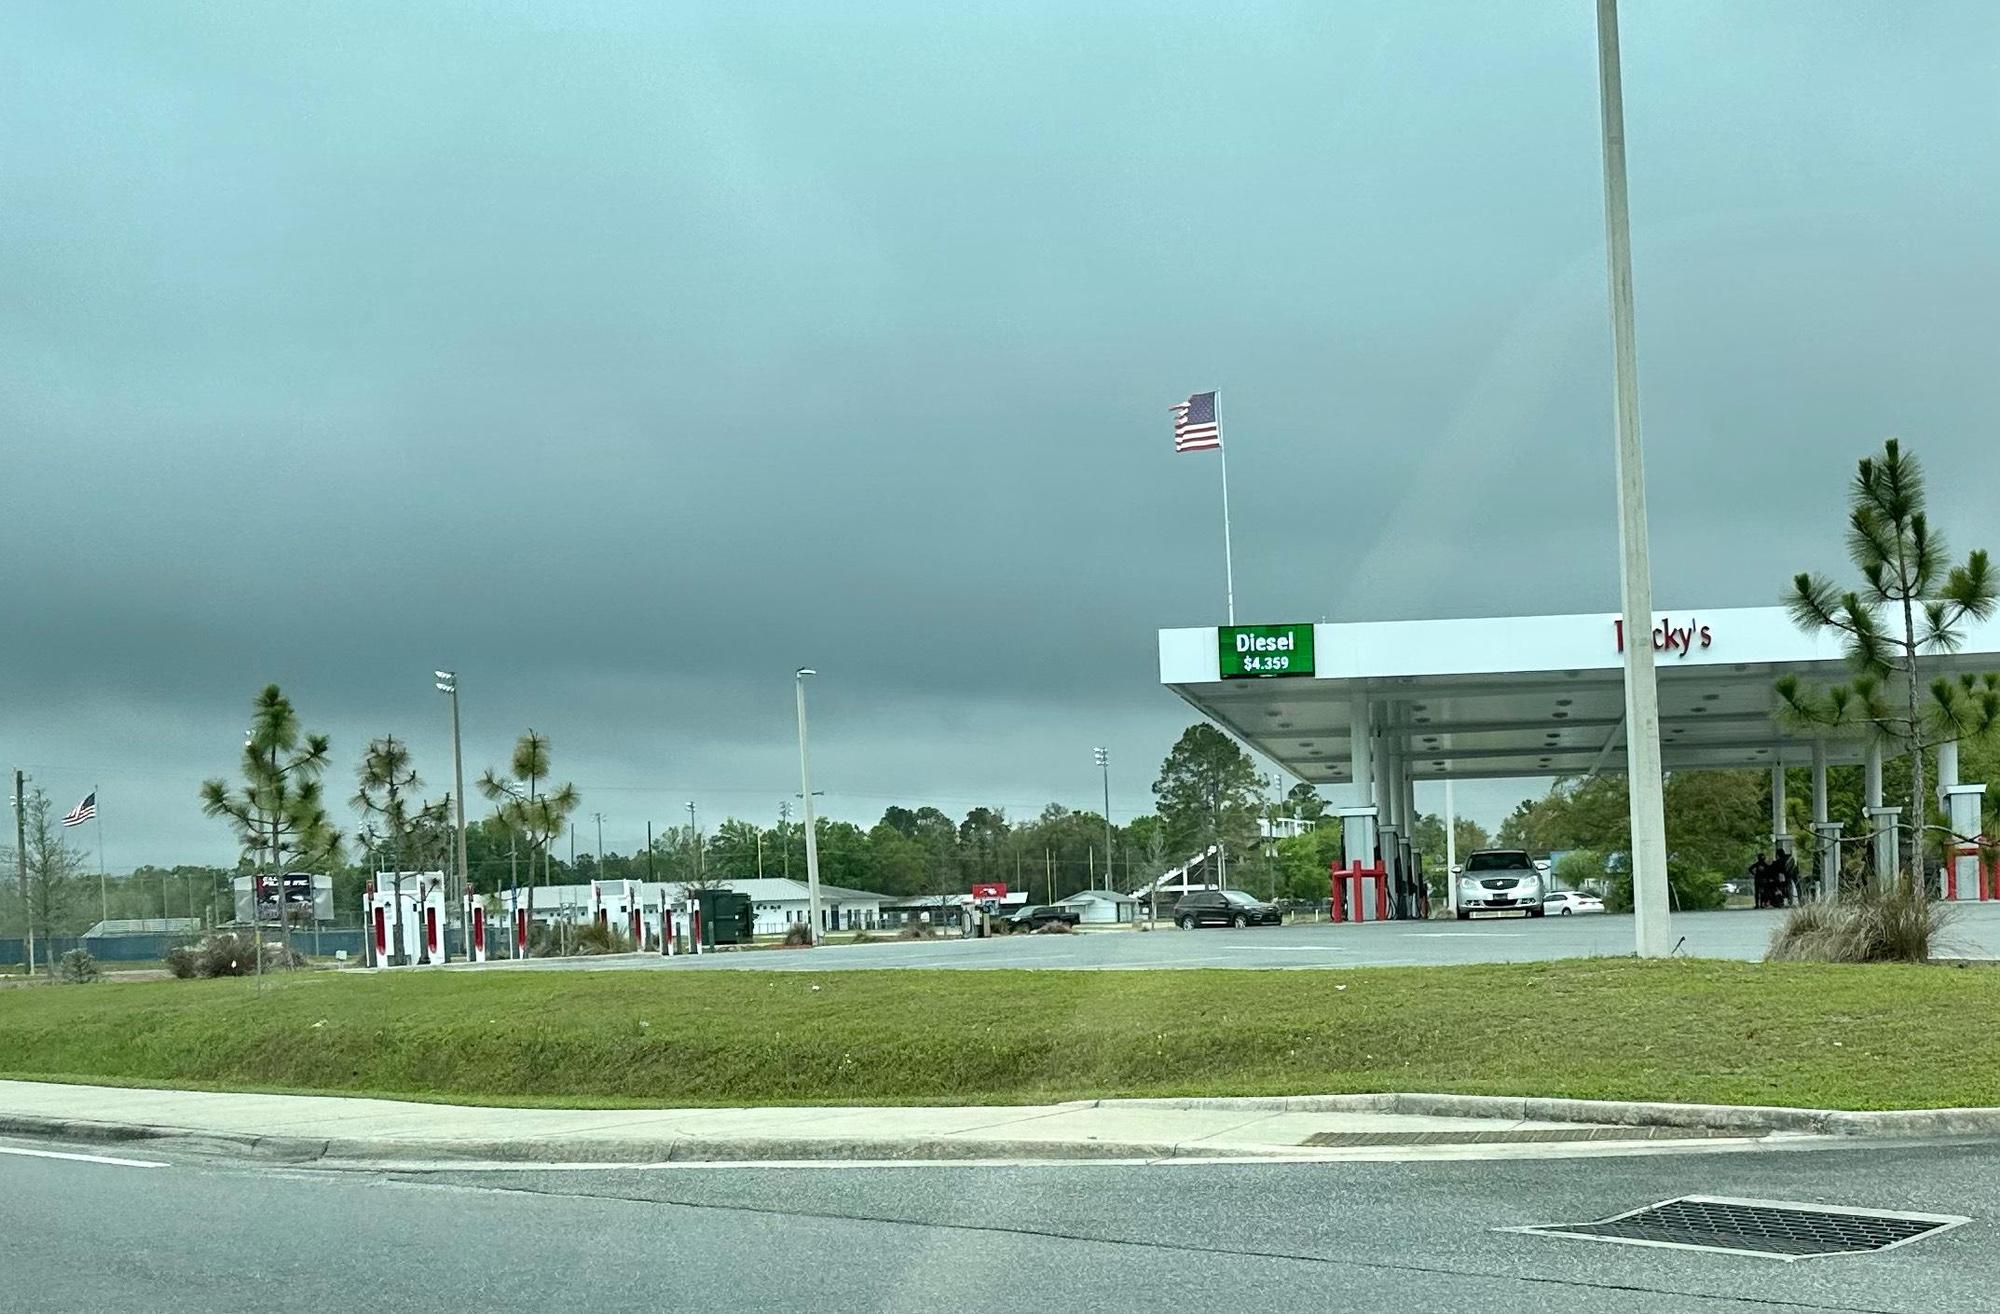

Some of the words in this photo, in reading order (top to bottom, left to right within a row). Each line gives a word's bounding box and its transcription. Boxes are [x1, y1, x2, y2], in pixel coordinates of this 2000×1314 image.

[1236, 631, 1294, 652] Diesel
[1614, 617, 1712, 658] cky's
[1243, 655, 1289, 671] $4.359
